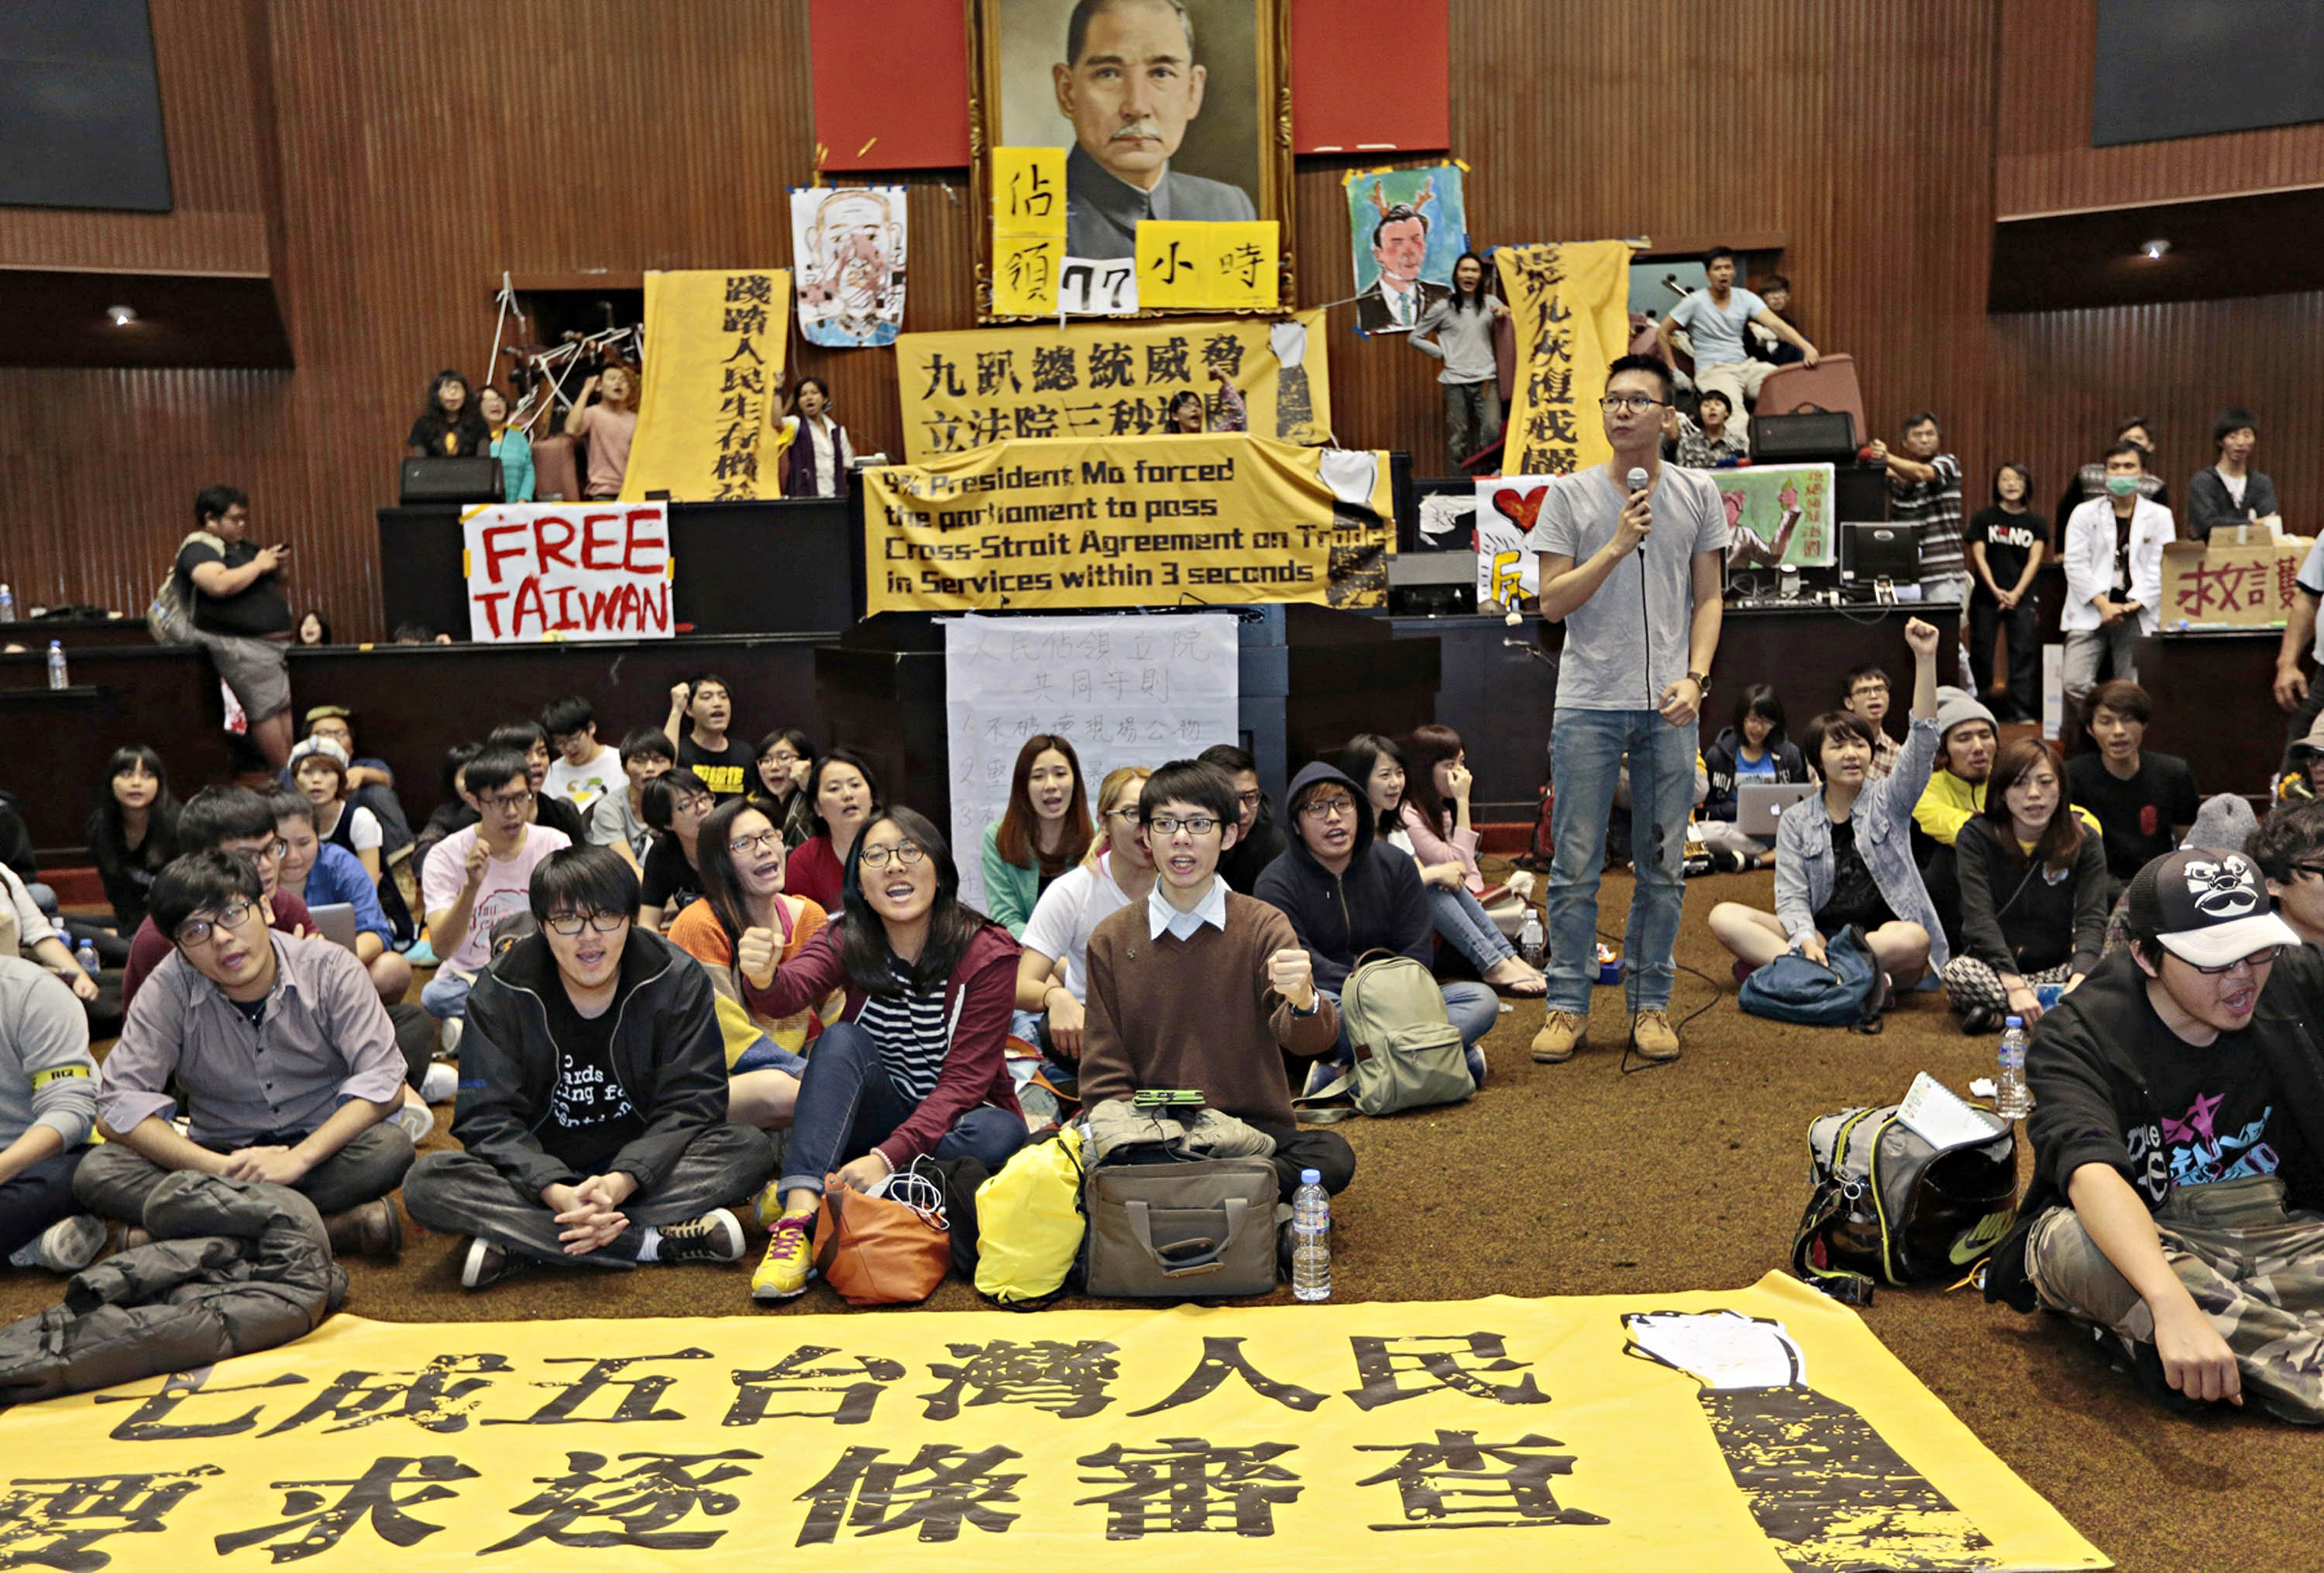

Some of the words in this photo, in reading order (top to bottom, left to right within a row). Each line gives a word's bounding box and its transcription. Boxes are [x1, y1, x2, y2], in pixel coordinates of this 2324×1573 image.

[1151, 241, 1264, 287] 小時
[930, 466, 1074, 496] President
[1135, 457, 1233, 483] forced
[884, 504, 931, 528] the
[939, 497, 1098, 532] parliament
[1105, 497, 1136, 519] to
[1146, 499, 1217, 522] pass
[483, 509, 665, 584] FREE
[885, 532, 1071, 560] Cross-Strait
[1080, 528, 1243, 558] Agreement
[1253, 532, 1288, 549] on
[887, 571, 912, 593] in
[921, 570, 1052, 594] Services
[1061, 563, 1152, 587] within
[1161, 563, 1178, 585] 3
[1188, 559, 1314, 583] seconds
[2175, 556, 2296, 617] 救護
[475, 574, 671, 638] TAIWAN
[1023, 669, 1169, 704] 共同守則
[95, 1330, 1552, 1441] 七成五台灣人民
[0, 1429, 1611, 1572] 要求逐條審查
